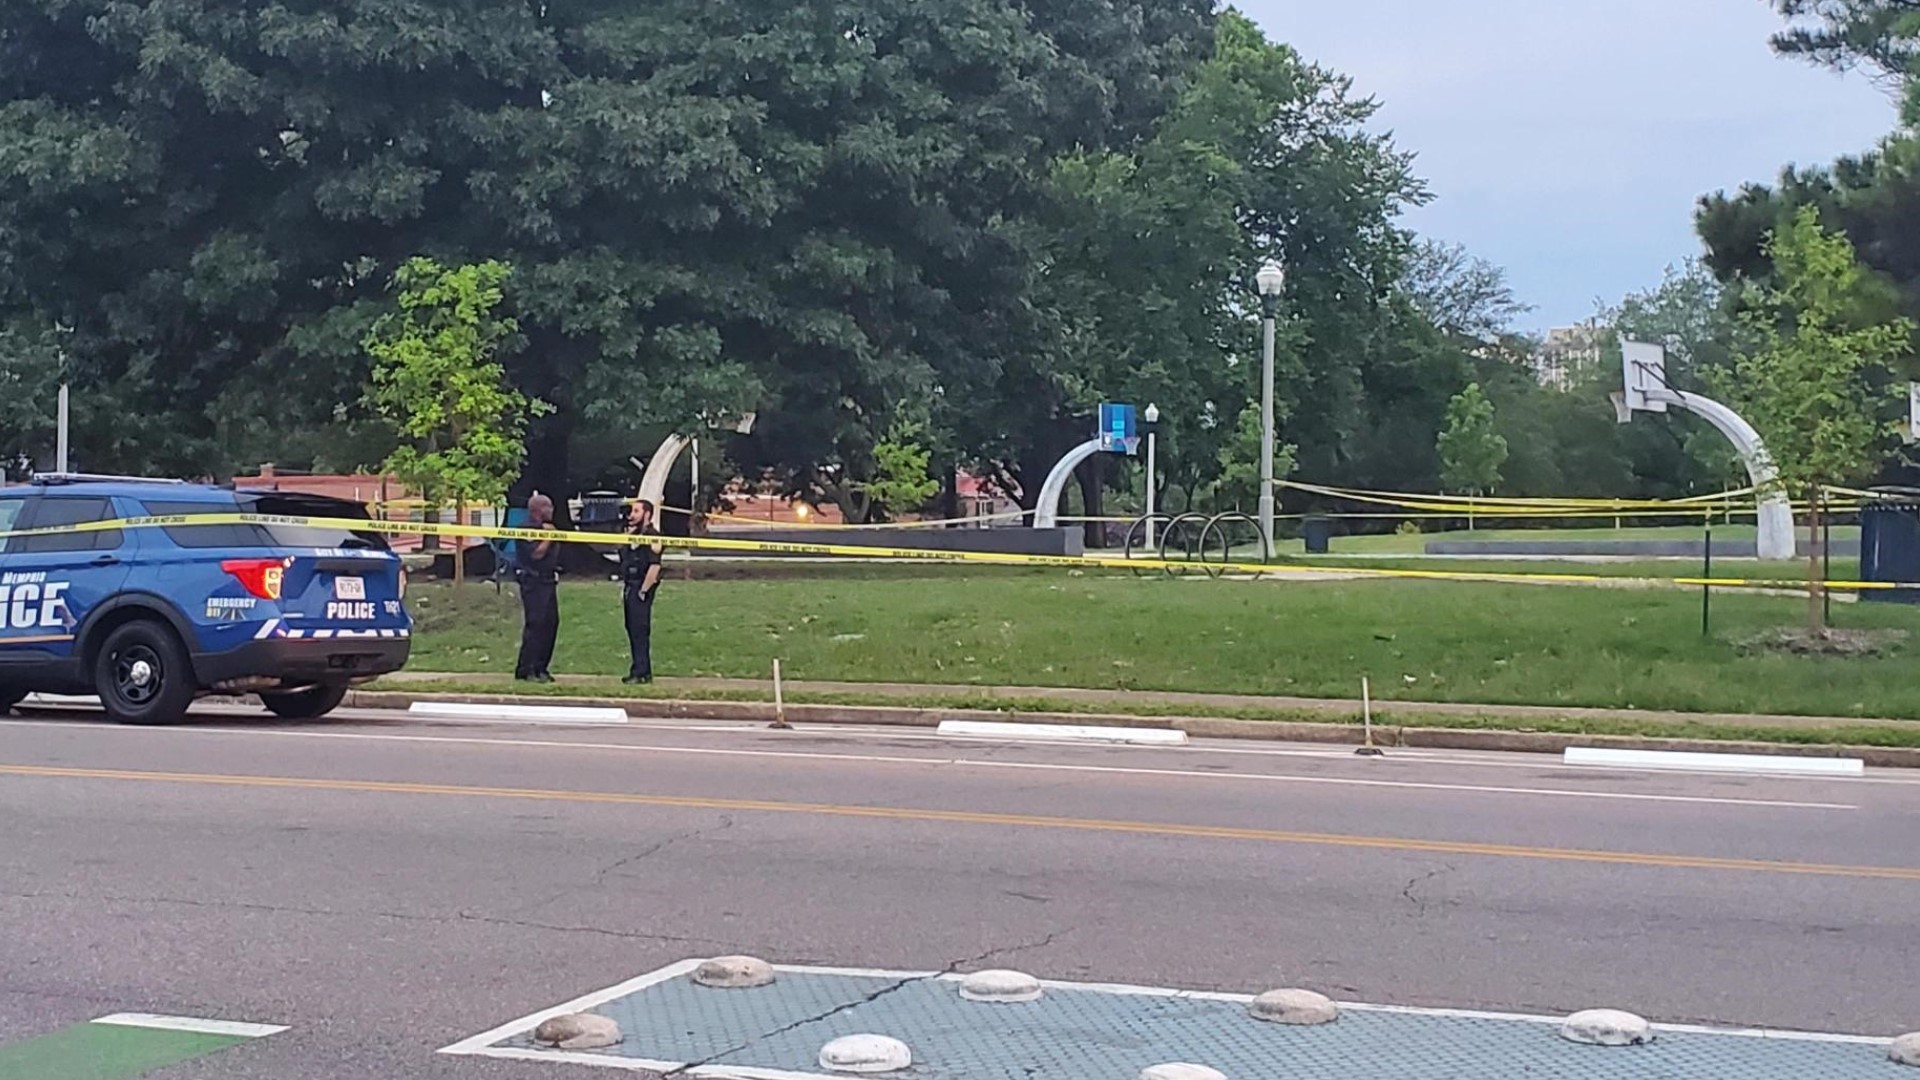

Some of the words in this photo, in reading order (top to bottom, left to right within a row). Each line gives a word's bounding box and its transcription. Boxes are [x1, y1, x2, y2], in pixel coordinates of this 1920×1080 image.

[1, 571, 47, 584] MEMPHIS
[207, 597, 257, 608] EMERGENCY
[327, 601, 376, 619] POLICE
